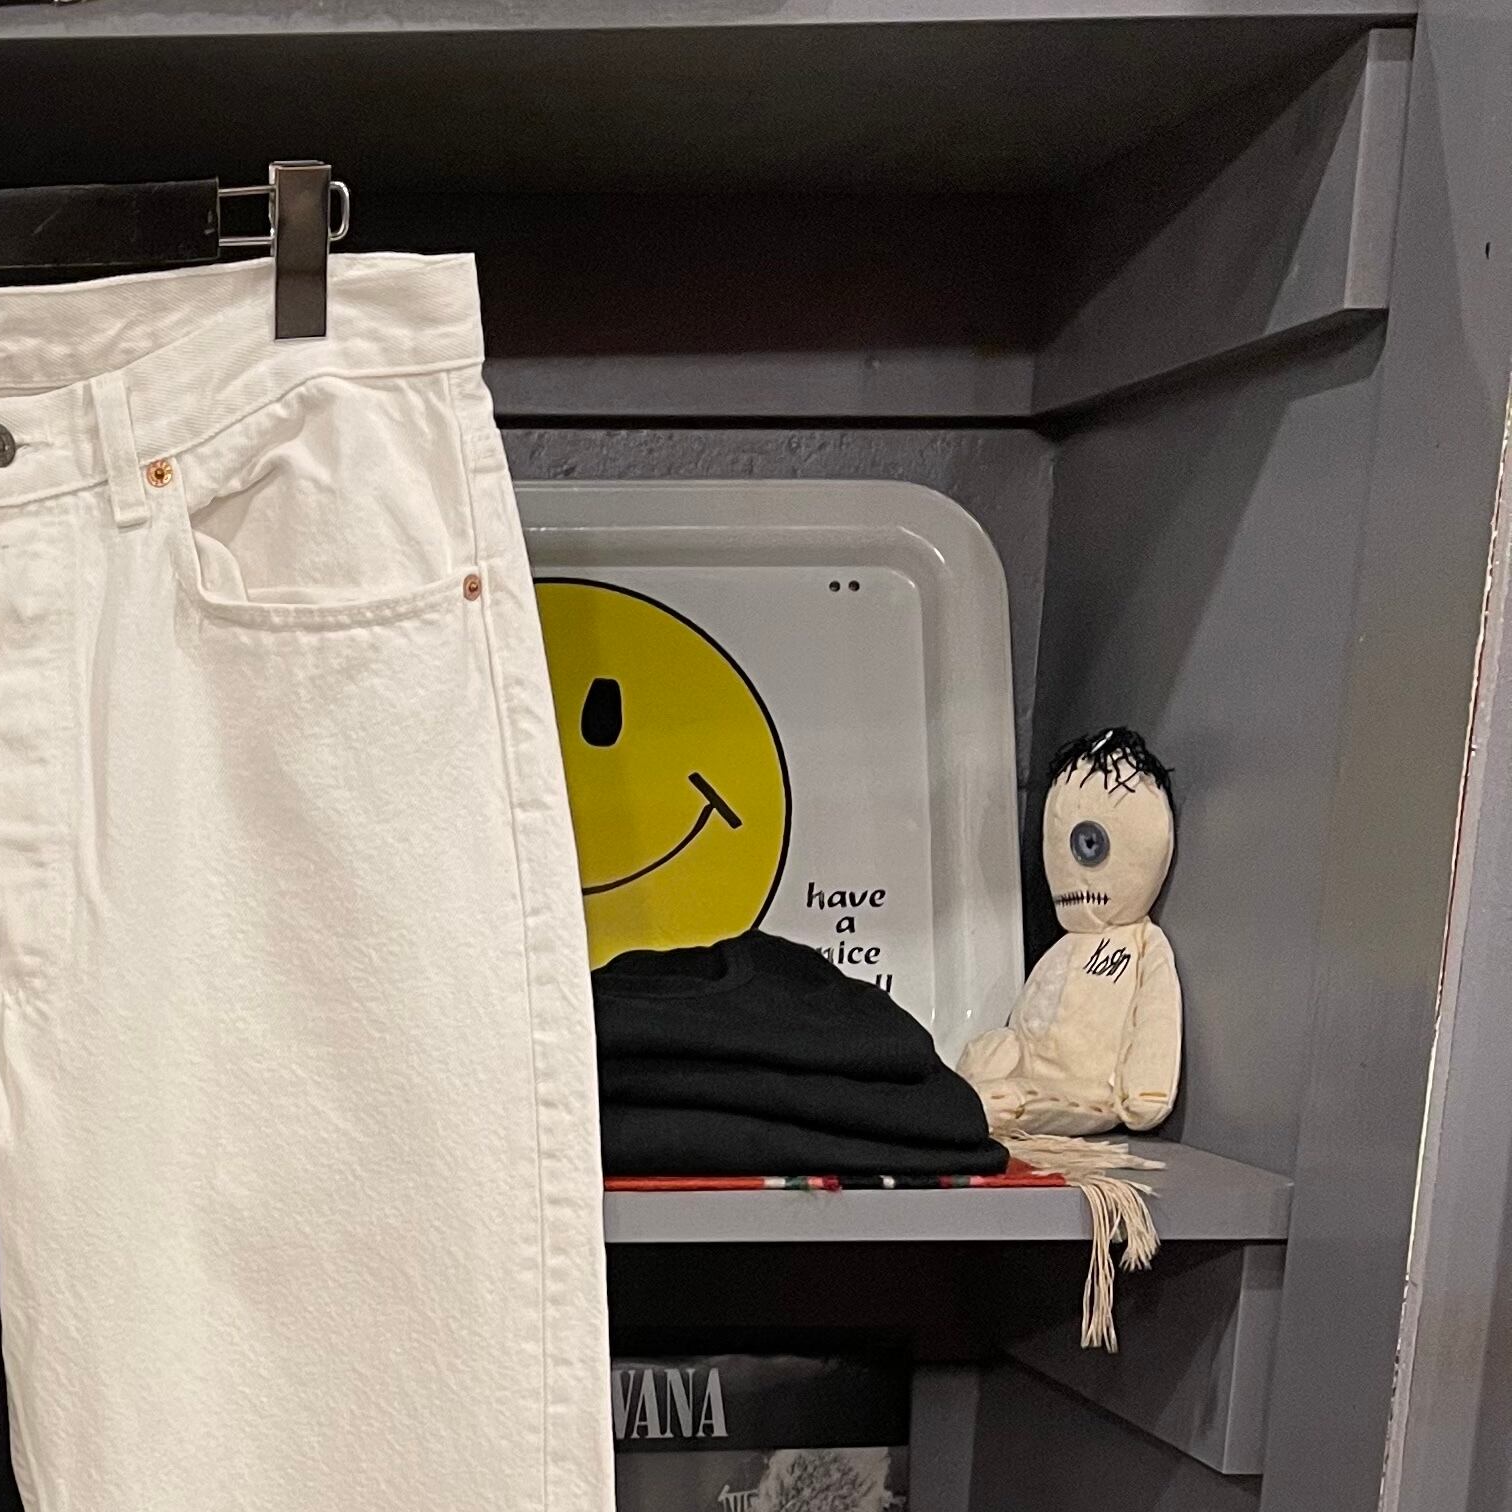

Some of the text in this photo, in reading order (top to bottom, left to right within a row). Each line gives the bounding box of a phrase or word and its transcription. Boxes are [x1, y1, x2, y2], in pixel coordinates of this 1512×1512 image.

[807, 882, 886, 910] have
[835, 916, 855, 933] a
[611, 1368, 728, 1439] VANA
